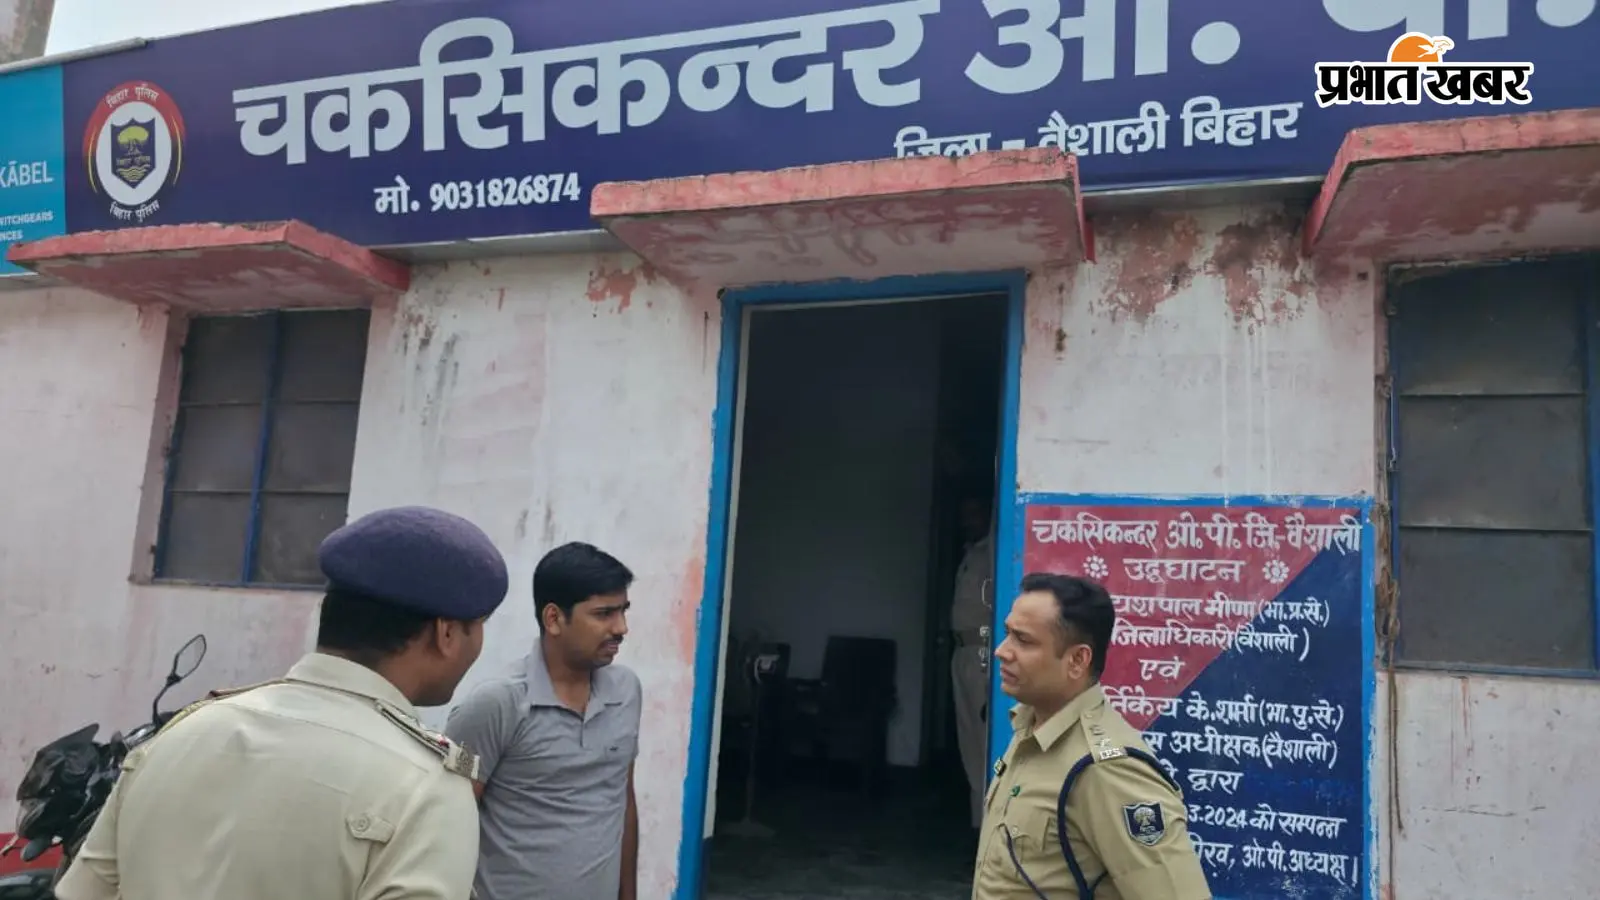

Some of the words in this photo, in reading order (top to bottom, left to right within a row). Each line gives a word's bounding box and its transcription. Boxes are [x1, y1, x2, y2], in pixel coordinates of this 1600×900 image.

[232, 0, 942, 165] चकसिकन्दर
[1180, 95, 1304, 147] बिहार
[374, 174, 421, 214] मो.
[429, 172, 581, 212] 9031826874
[1032, 512, 1160, 553] चकसिकन्दर
[1139, 656, 1186, 680] एवं
[1188, 768, 1244, 795] द्वारा
